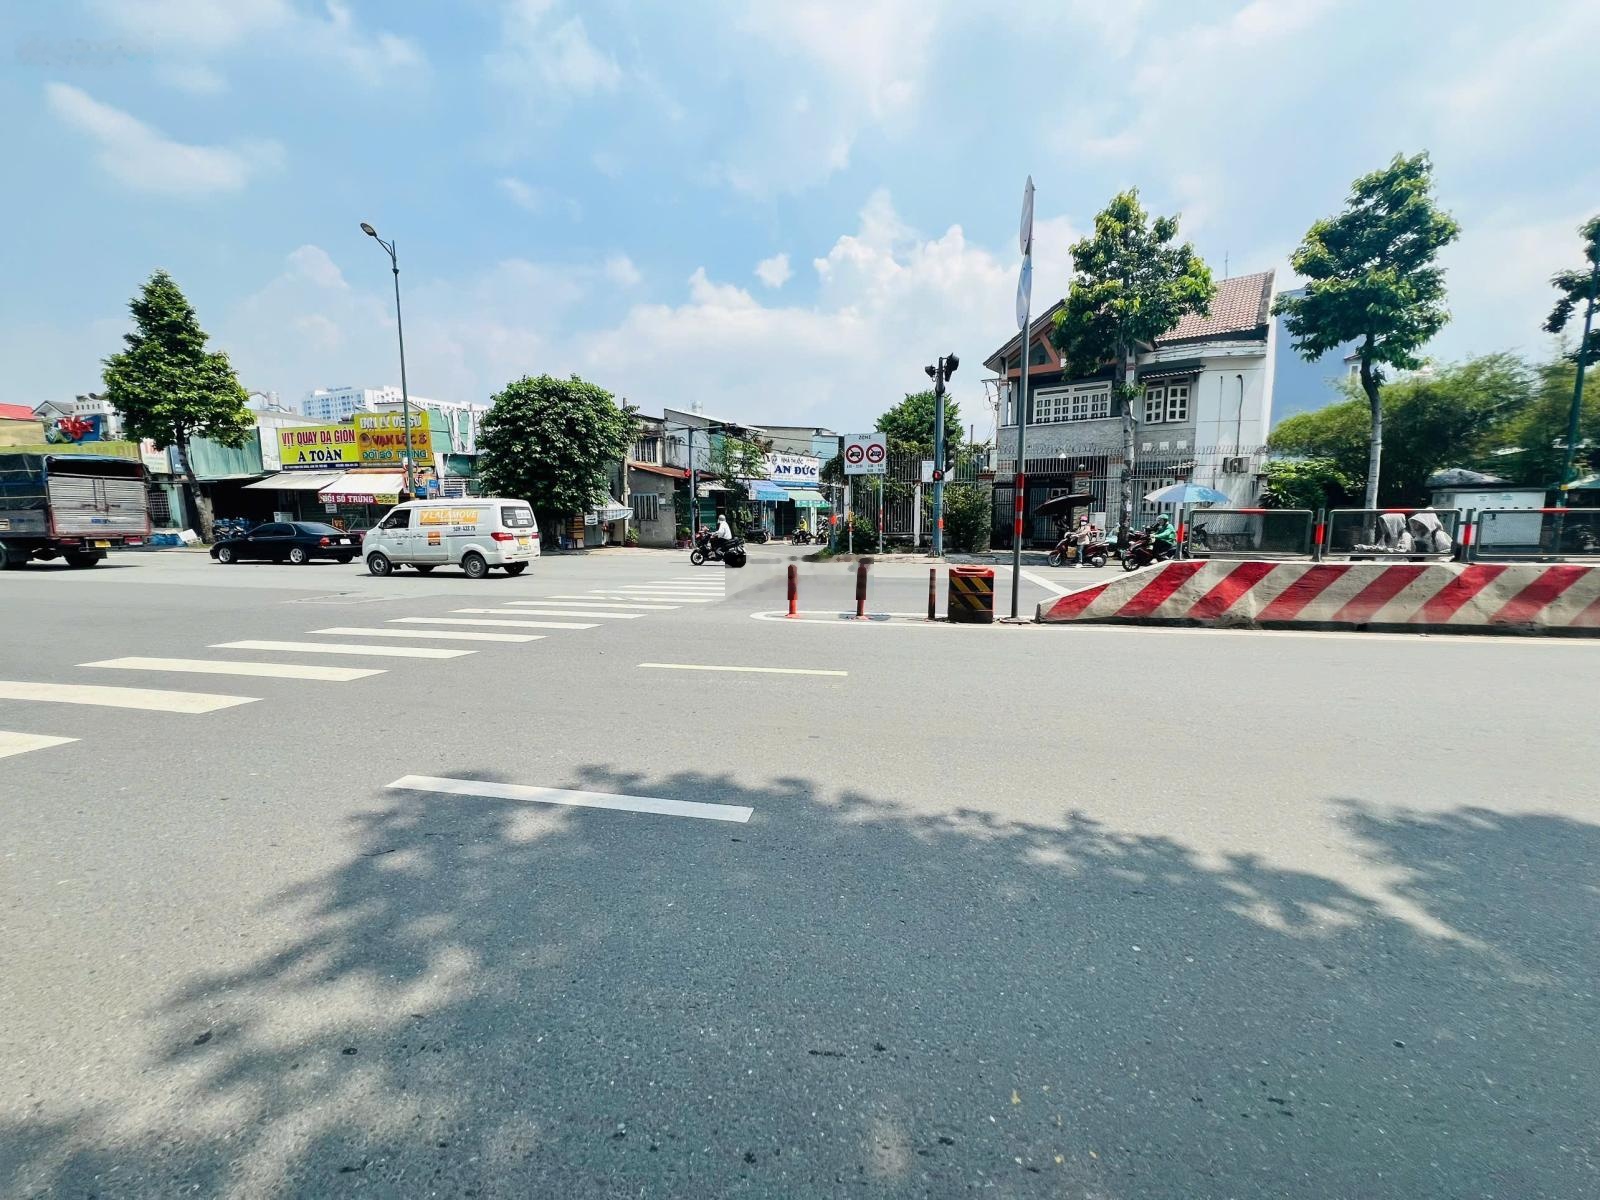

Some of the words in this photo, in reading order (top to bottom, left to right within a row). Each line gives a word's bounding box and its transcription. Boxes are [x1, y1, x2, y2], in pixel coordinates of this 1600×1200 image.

[282, 432, 294, 449] VỊT
[297, 431, 317, 447] QUAY
[320, 430, 332, 444] DA
[298, 451, 306, 462] A
[309, 447, 342, 462] TOÀN
[774, 465, 791, 474] AN
[794, 464, 817, 476] ĐỨC
